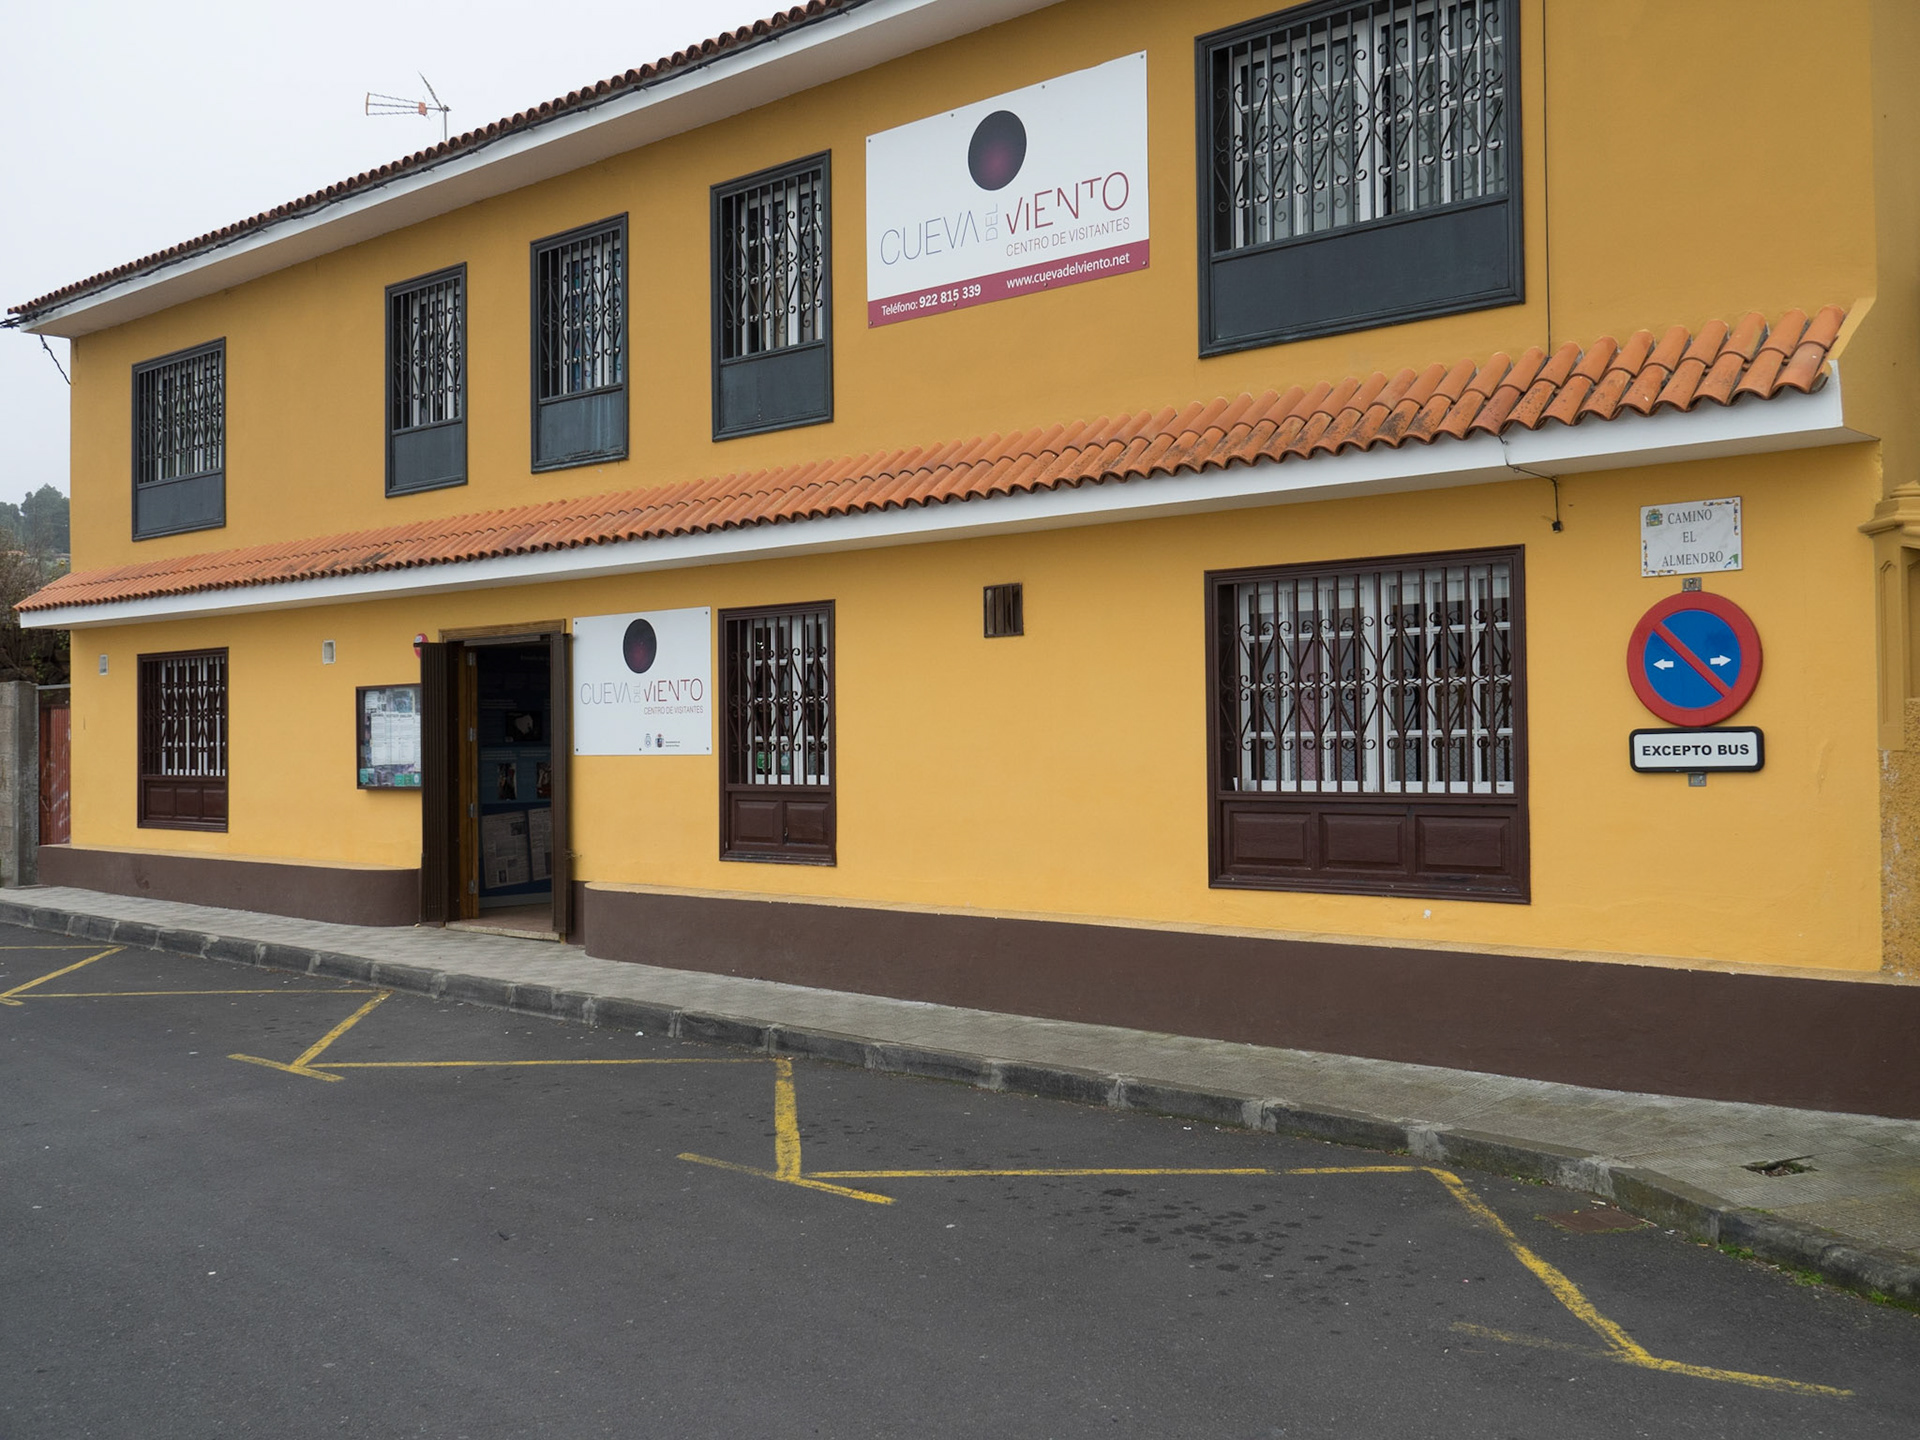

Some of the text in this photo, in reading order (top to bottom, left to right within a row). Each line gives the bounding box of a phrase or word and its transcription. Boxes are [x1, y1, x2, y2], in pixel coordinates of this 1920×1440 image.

[880, 171, 1130, 265] CUEVA DEL VIENTO
[1006, 216, 1130, 257] CENTRO DE VISITANTES
[1006, 252, 1130, 289] www.cuevadelviento.net
[881, 284, 981, 316] Teléfono: 922 815 339
[1667, 508, 1713, 525] CAMINO
[1682, 531, 1697, 543] EL
[1662, 550, 1724, 568] ALMENDRO
[580, 682, 632, 705] CUEVA
[643, 678, 704, 703] VIENTO
[643, 705, 704, 715] CENTRO DE VISITANTES
[1642, 744, 1750, 756] EXCEPTO BUS
